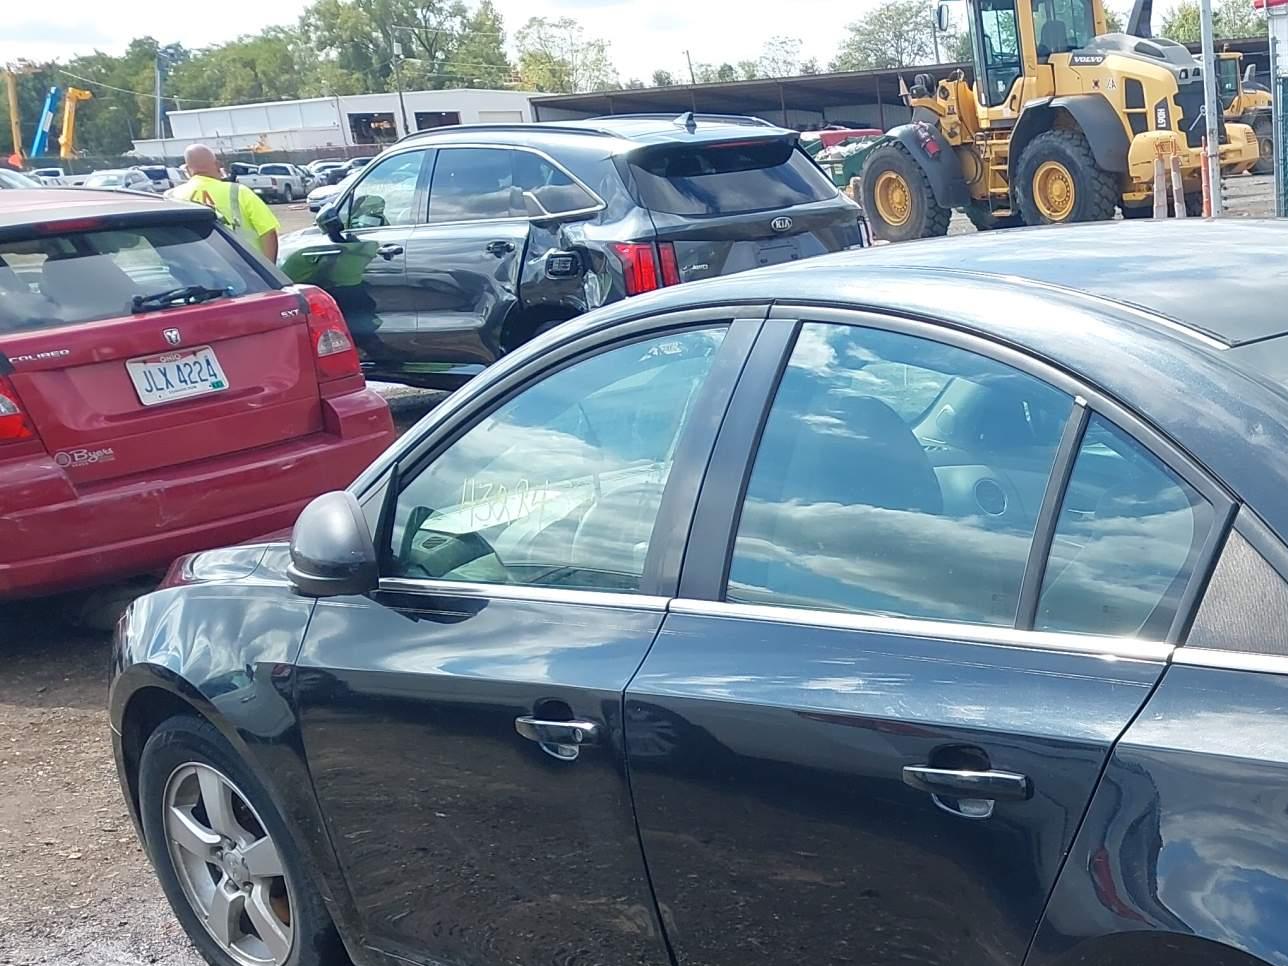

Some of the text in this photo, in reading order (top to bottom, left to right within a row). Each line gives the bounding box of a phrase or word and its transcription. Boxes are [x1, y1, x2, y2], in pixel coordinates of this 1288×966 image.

[1156, 108, 1167, 128] L90H
[159, 353, 182, 364] OHIO
[143, 358, 218, 393] JLX 4224
